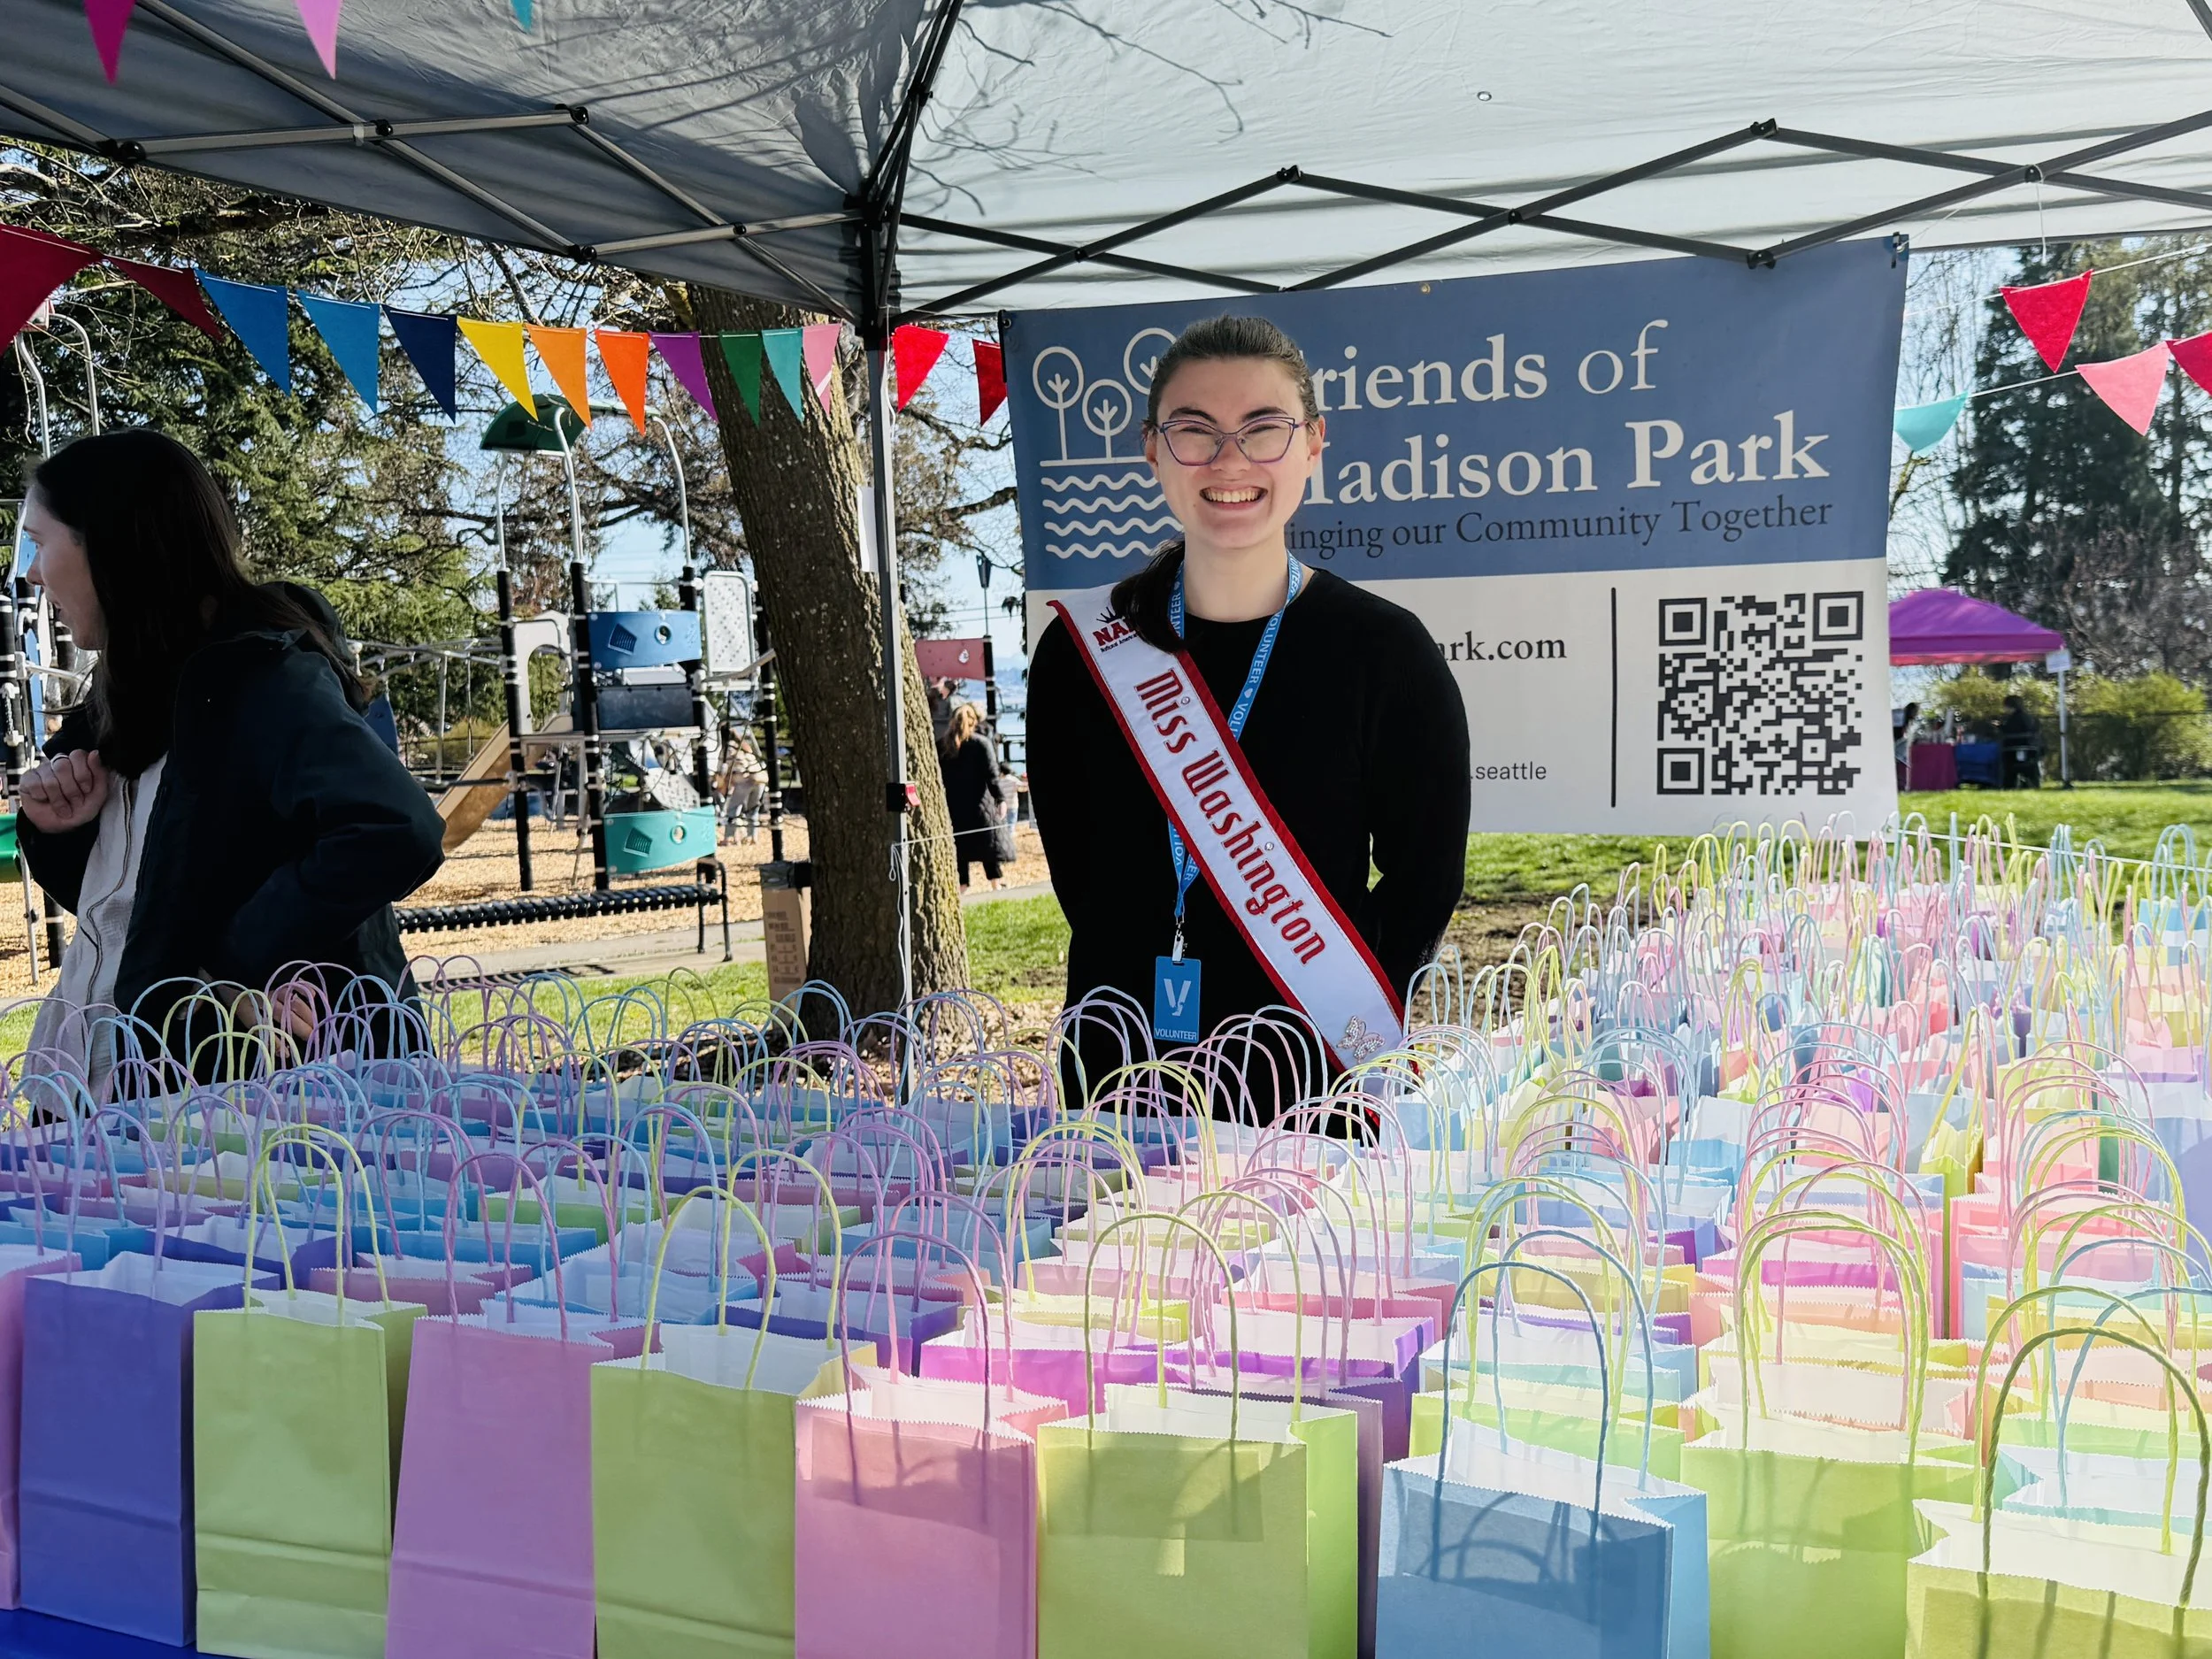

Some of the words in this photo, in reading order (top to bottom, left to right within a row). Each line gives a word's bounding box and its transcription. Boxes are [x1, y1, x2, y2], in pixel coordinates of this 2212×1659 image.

[1302, 333, 1548, 412] riends
[1578, 319, 1669, 395] of
[1624, 410, 1831, 489] Park
[1286, 520, 1384, 561] inging
[1392, 523, 1448, 547] our
[1455, 505, 1662, 547] Community
[1671, 494, 1834, 543] Together
[1248, 611, 1283, 685] VOLUNTEER
[1133, 667, 1199, 754] Miss
[1181, 747, 1326, 966] Washington
[1154, 1027, 1197, 1041] VOLUNTEER
